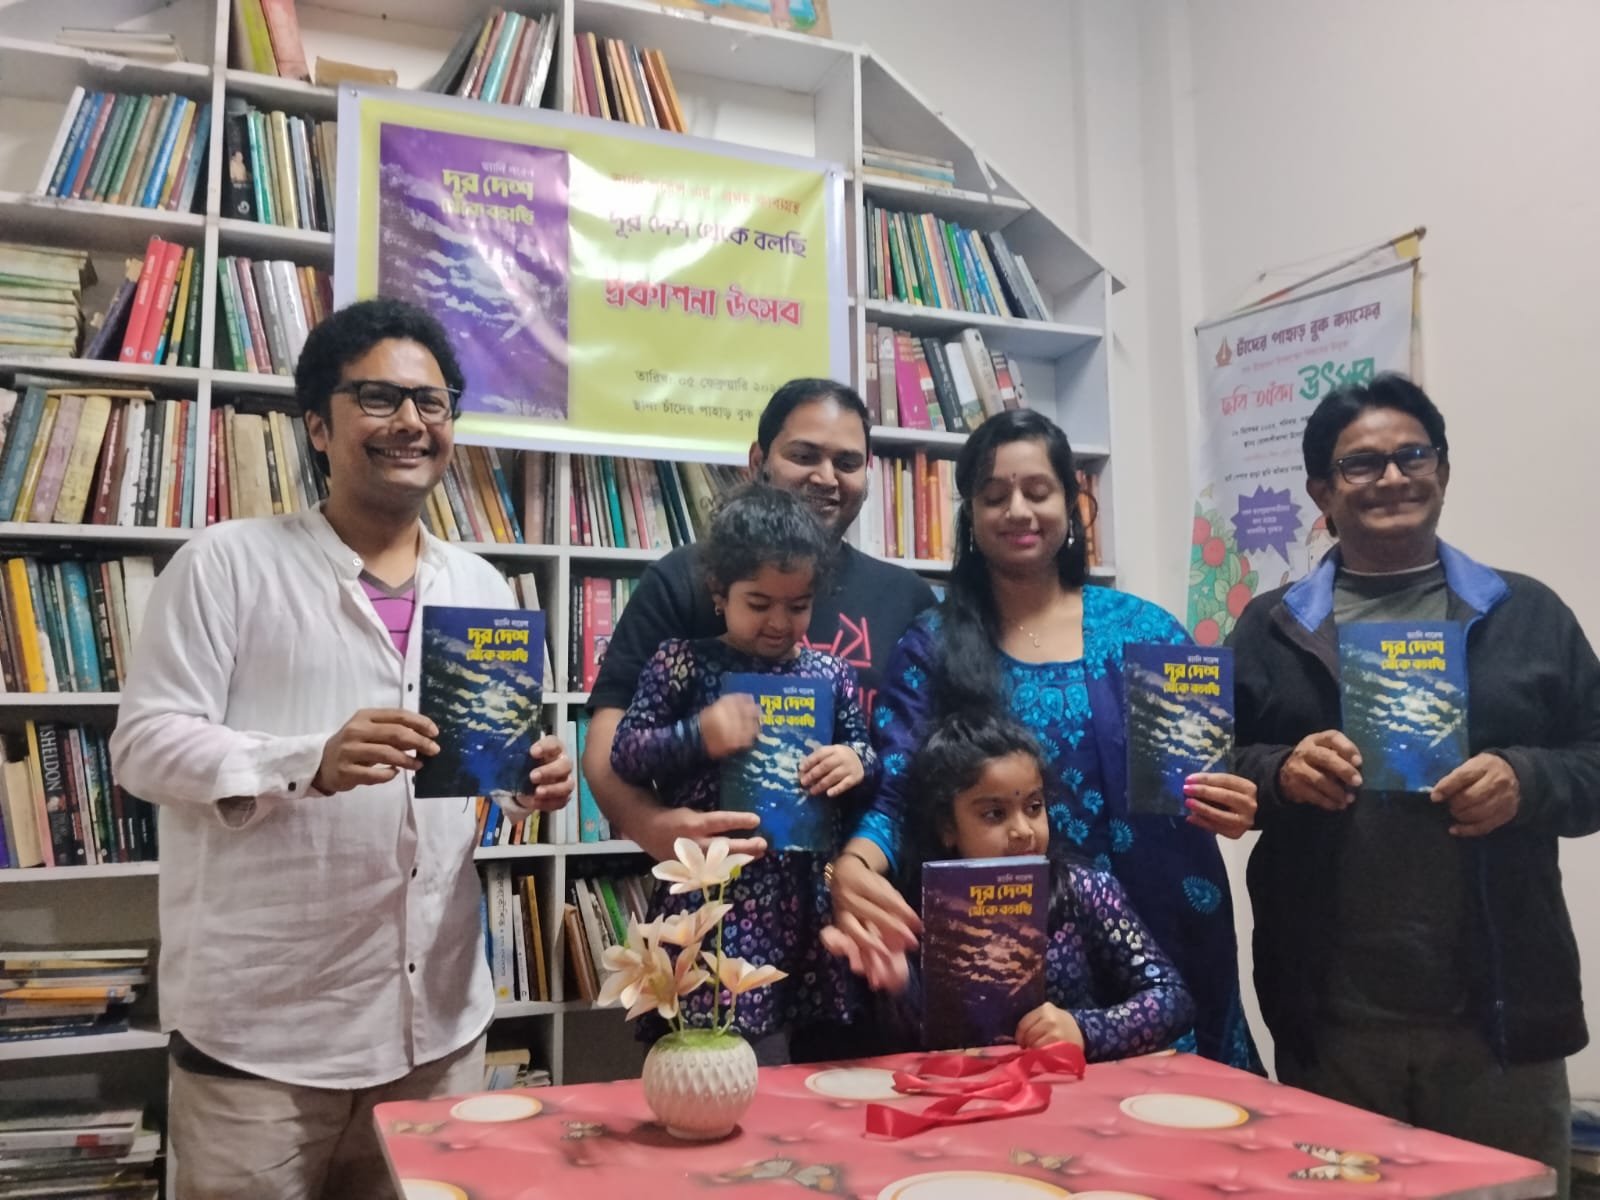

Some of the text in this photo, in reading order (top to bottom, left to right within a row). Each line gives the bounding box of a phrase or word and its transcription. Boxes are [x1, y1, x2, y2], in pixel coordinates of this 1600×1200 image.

[442, 168, 479, 205] দূর
[483, 175, 535, 202] দেশ
[609, 211, 642, 239] দূর
[648, 213, 690, 239] দেশ
[753, 229, 807, 258] বলছি
[605, 278, 801, 325] প্রকাশনা উৎসব
[1236, 335, 1268, 357] চাঁদের
[1271, 324, 1306, 345] পাহাড়
[1310, 317, 1329, 342] বুক
[1333, 302, 1381, 328] ক্যাফের
[468, 628, 529, 649] দূর দেশ
[1381, 640, 1444, 659] দূর দেশ
[1164, 663, 1219, 682] দূর দেশ
[760, 695, 815, 715] দূর দেশ
[40, 730, 63, 791] SHELDON
[969, 883, 1033, 906] দূর দেশ
